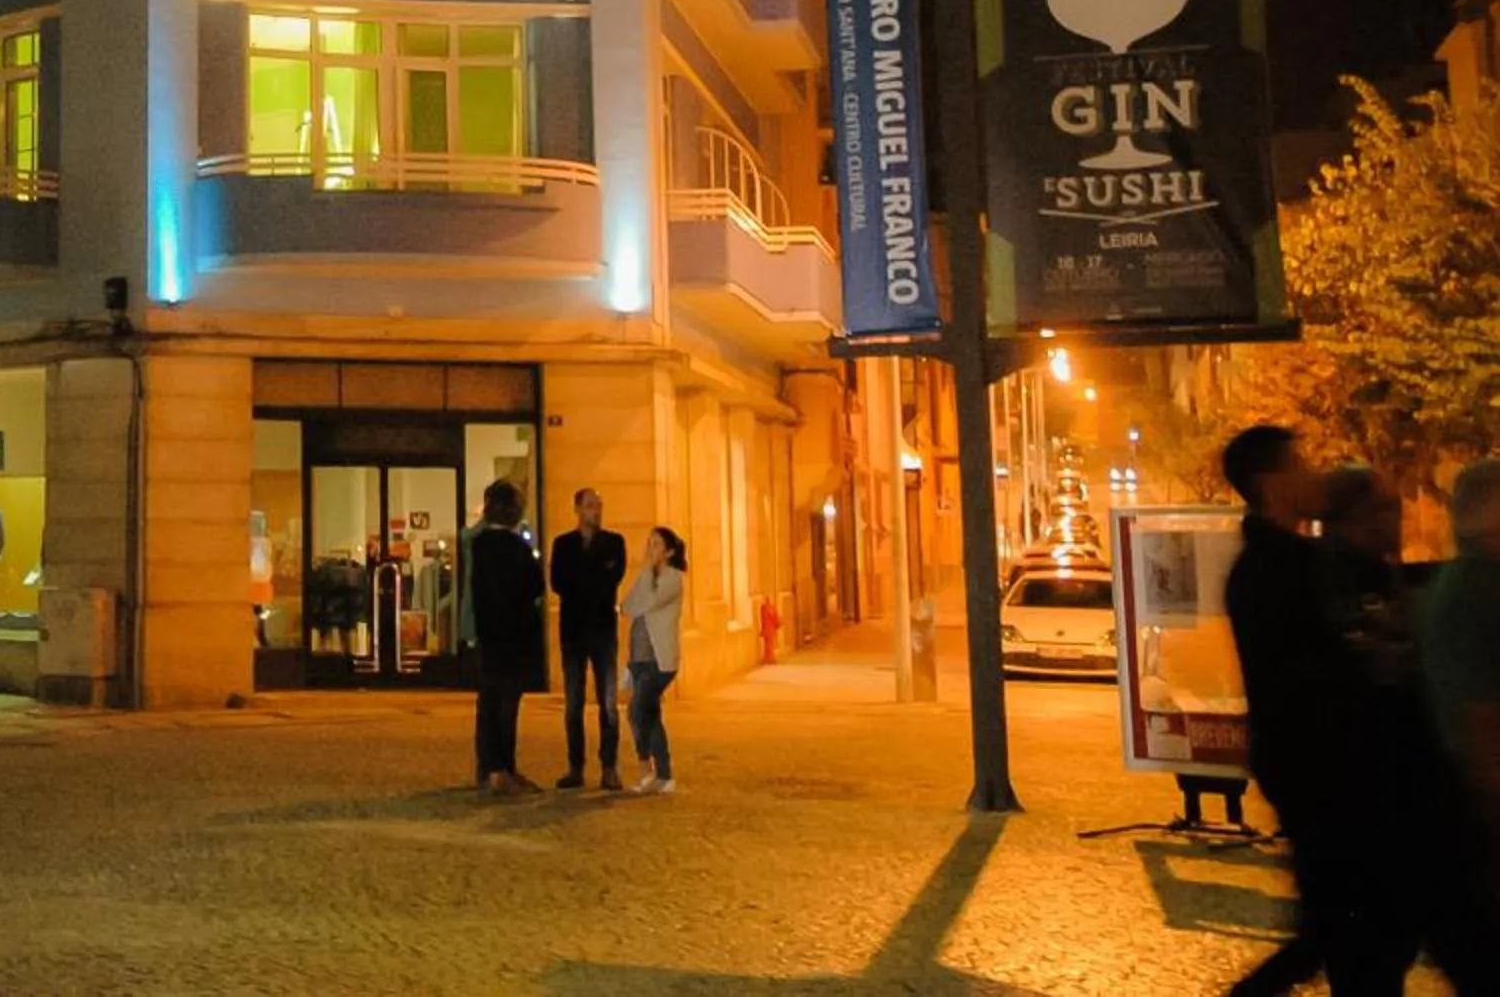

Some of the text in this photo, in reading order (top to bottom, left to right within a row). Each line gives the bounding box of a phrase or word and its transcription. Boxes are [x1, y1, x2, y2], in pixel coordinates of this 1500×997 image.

[844, 93, 862, 152] CENTRO
[874, 50, 908, 171] MIGUEL
[1052, 80, 1197, 134] GIN
[848, 156, 867, 230] CULTURAL
[1056, 171, 1204, 207] SUSHI
[881, 177, 919, 304] FRANCO
[1100, 232, 1158, 249] LEIRIA
